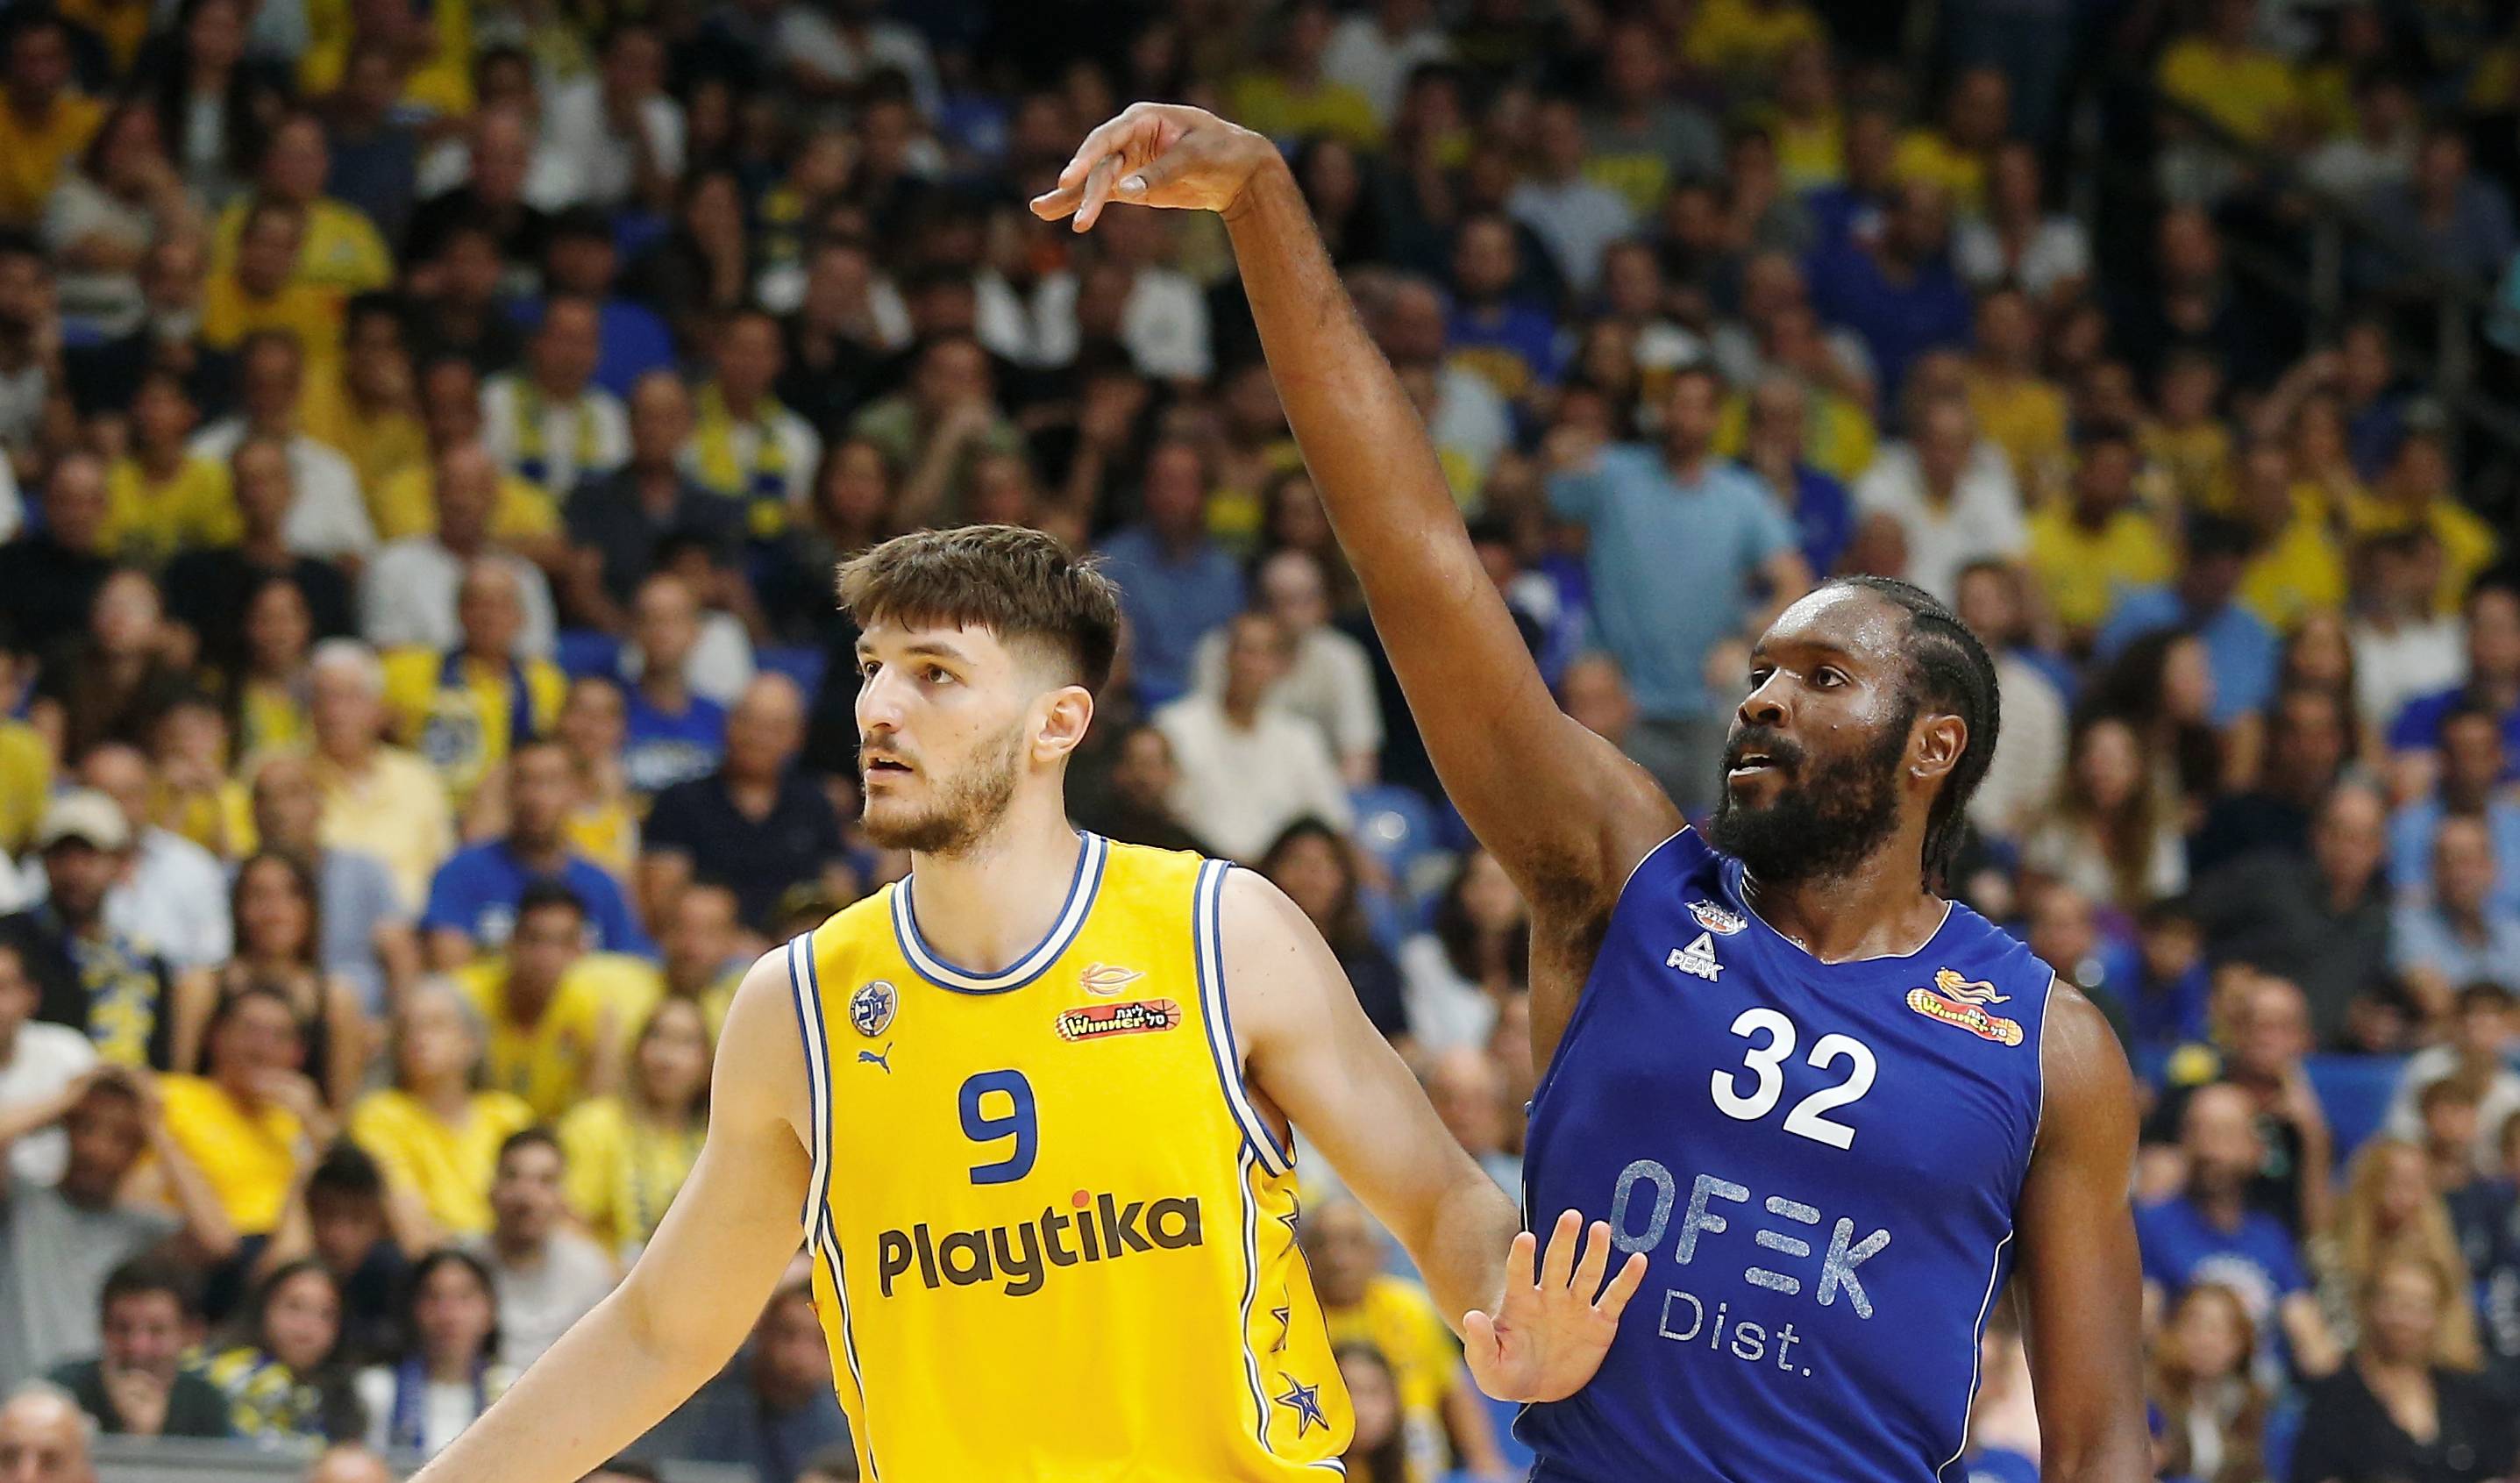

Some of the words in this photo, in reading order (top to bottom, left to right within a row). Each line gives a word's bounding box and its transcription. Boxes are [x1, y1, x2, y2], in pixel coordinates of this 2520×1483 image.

[1667, 948, 1724, 982] PEAK
[1922, 996, 1989, 1032] Winner
[1066, 1015, 1145, 1036] Winner
[958, 1069, 1038, 1185] 9
[1710, 1007, 1878, 1151] 32
[879, 1189, 1204, 1297] Playtika
[1609, 1159, 1892, 1320] OFEK
[1657, 1288, 1812, 1378] Dist.
